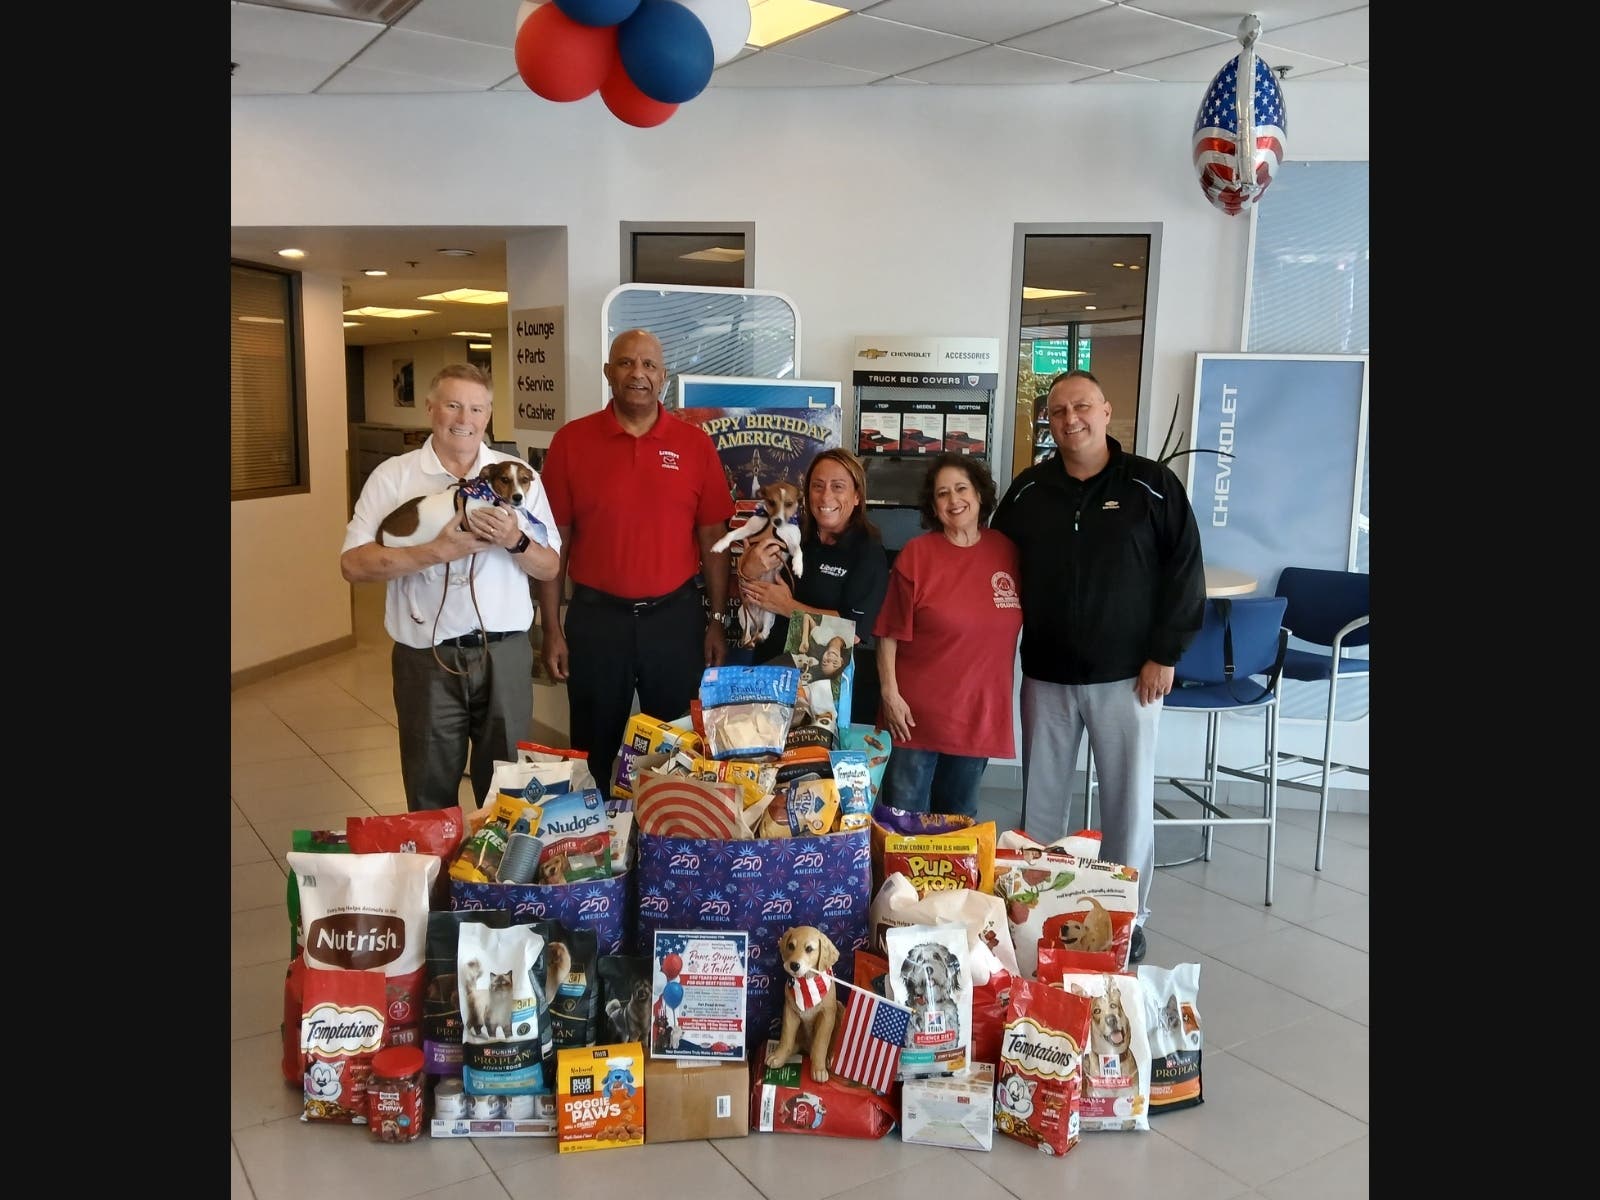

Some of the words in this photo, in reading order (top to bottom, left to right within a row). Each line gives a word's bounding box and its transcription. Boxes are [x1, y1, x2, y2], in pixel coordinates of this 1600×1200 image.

[524, 321, 555, 340] Lounge
[524, 348, 546, 363] Parts
[945, 352, 990, 360] ACCESSORIES
[525, 375, 554, 392] Service
[868, 375, 897, 383] TRUCK
[900, 376, 919, 384] BED
[922, 377, 961, 385] COVERS
[526, 403, 556, 421] Cashier
[702, 416, 743, 436] APPY
[745, 414, 832, 442] BIRTHDAY
[716, 431, 793, 450] AMERICA
[1212, 384, 1238, 527] CHEVROLET
[801, 735, 829, 743] PLAN
[547, 814, 600, 835] Nudges
[669, 854, 700, 869] 250
[793, 852, 823, 869] 250
[853, 846, 870, 863] 25
[731, 856, 762, 871] 250
[578, 896, 610, 915] 250
[640, 897, 669, 912] 250
[700, 901, 730, 916] 250
[762, 899, 792, 915] 250
[822, 893, 852, 911] 250
[513, 903, 546, 917] 250
[579, 912, 610, 921] AMERICA
[640, 910, 669, 918] AMERICA
[823, 909, 852, 917] AMERICA
[316, 928, 397, 952] Nutrish
[852, 937, 869, 952] 25
[307, 1020, 379, 1045] Temptations
[500, 1051, 530, 1064] PLAN
[1009, 1034, 1073, 1067] Temptations
[1156, 1068, 1178, 1078] PRO
[377, 1103, 403, 1113] Chewy
[565, 1097, 611, 1112] DOGGIE
[571, 1103, 621, 1123] PAWS
[796, 1103, 808, 1125] ONE
